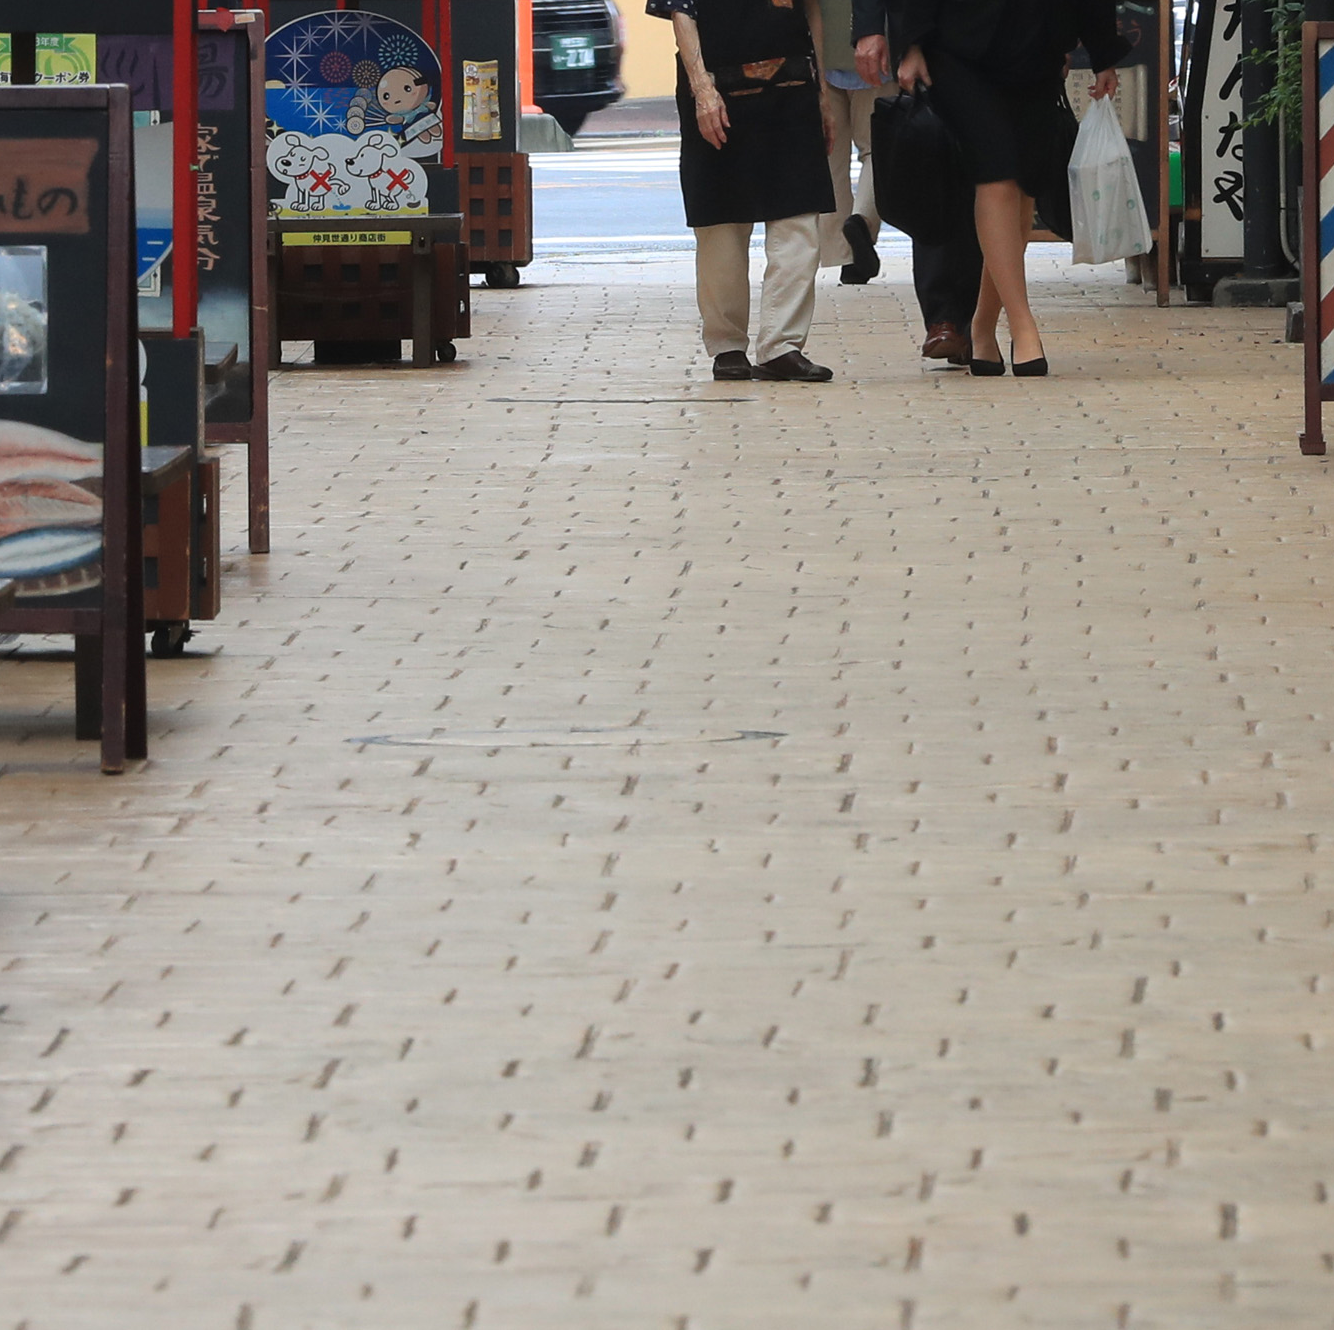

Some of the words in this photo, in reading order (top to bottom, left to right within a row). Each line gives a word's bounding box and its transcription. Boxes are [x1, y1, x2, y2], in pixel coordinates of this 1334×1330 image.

[312, 233, 387, 244] 仲見世通り商店街
